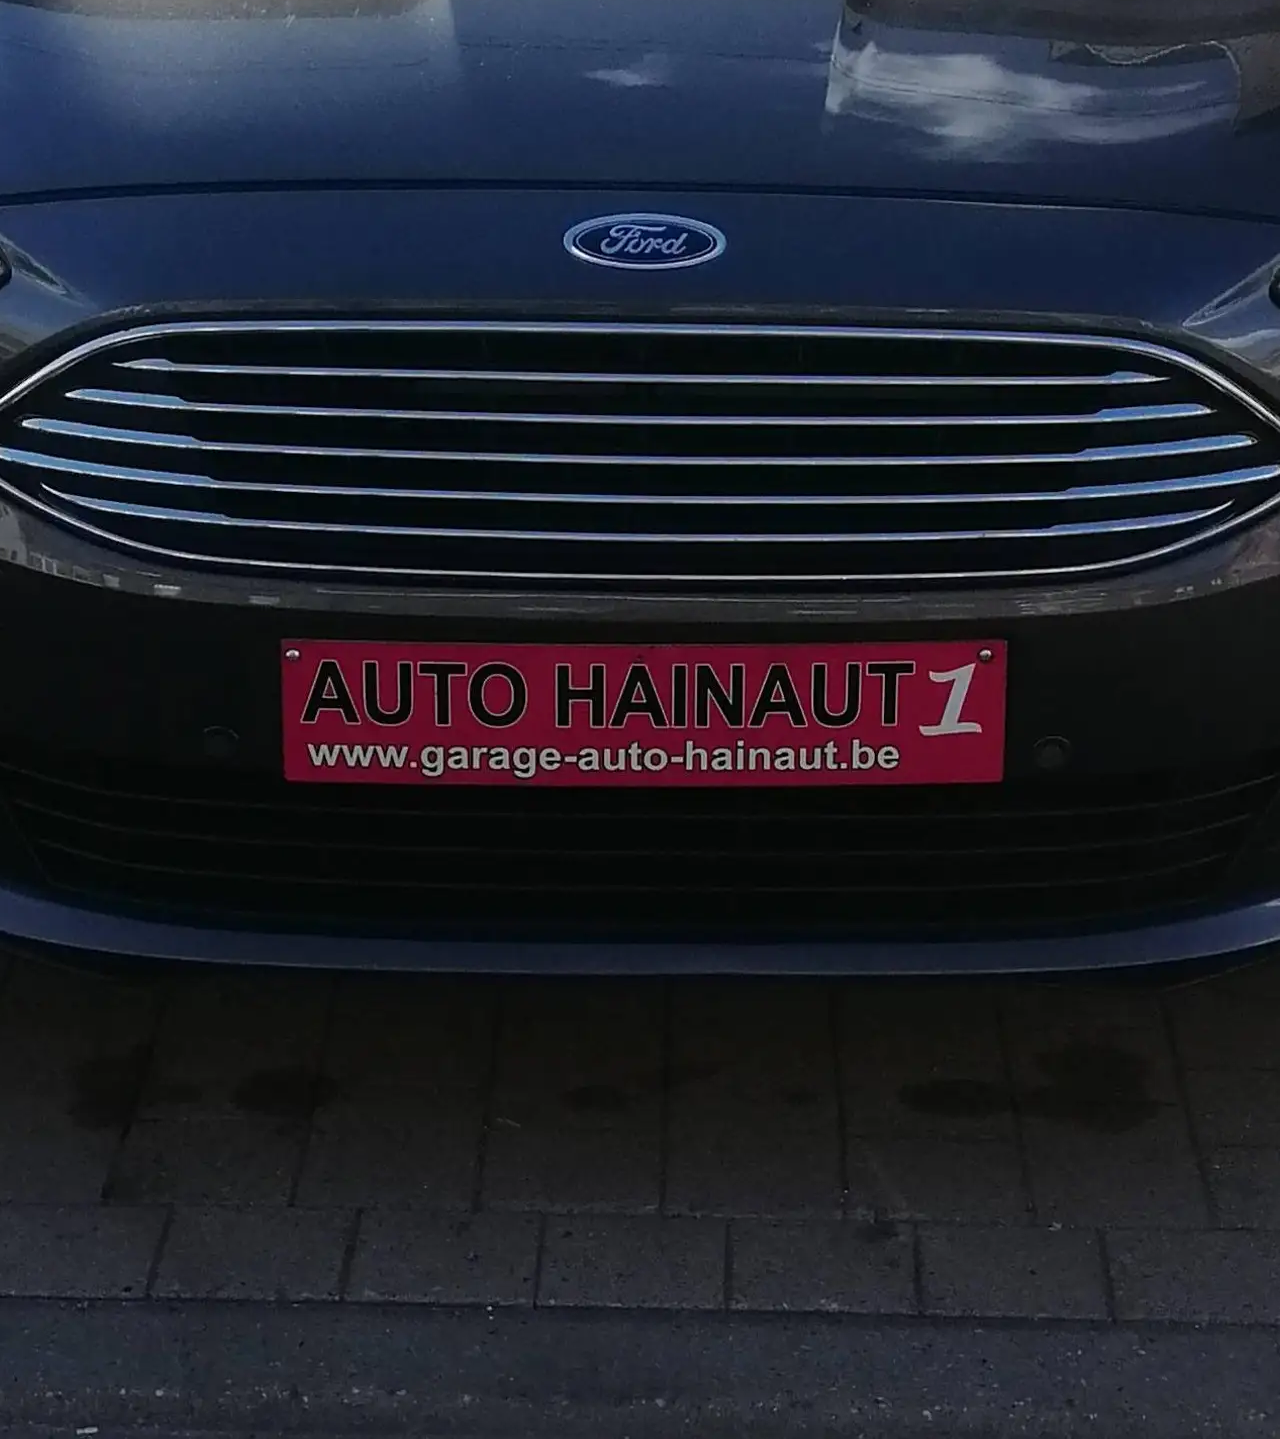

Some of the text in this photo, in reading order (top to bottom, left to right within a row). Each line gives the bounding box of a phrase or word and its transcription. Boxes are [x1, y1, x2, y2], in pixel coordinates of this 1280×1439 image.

[600, 224, 688, 255] Ford
[301, 659, 982, 736] AUTO HAINAUT 1
[307, 739, 900, 778] www.garage-auto-hainaut.be
